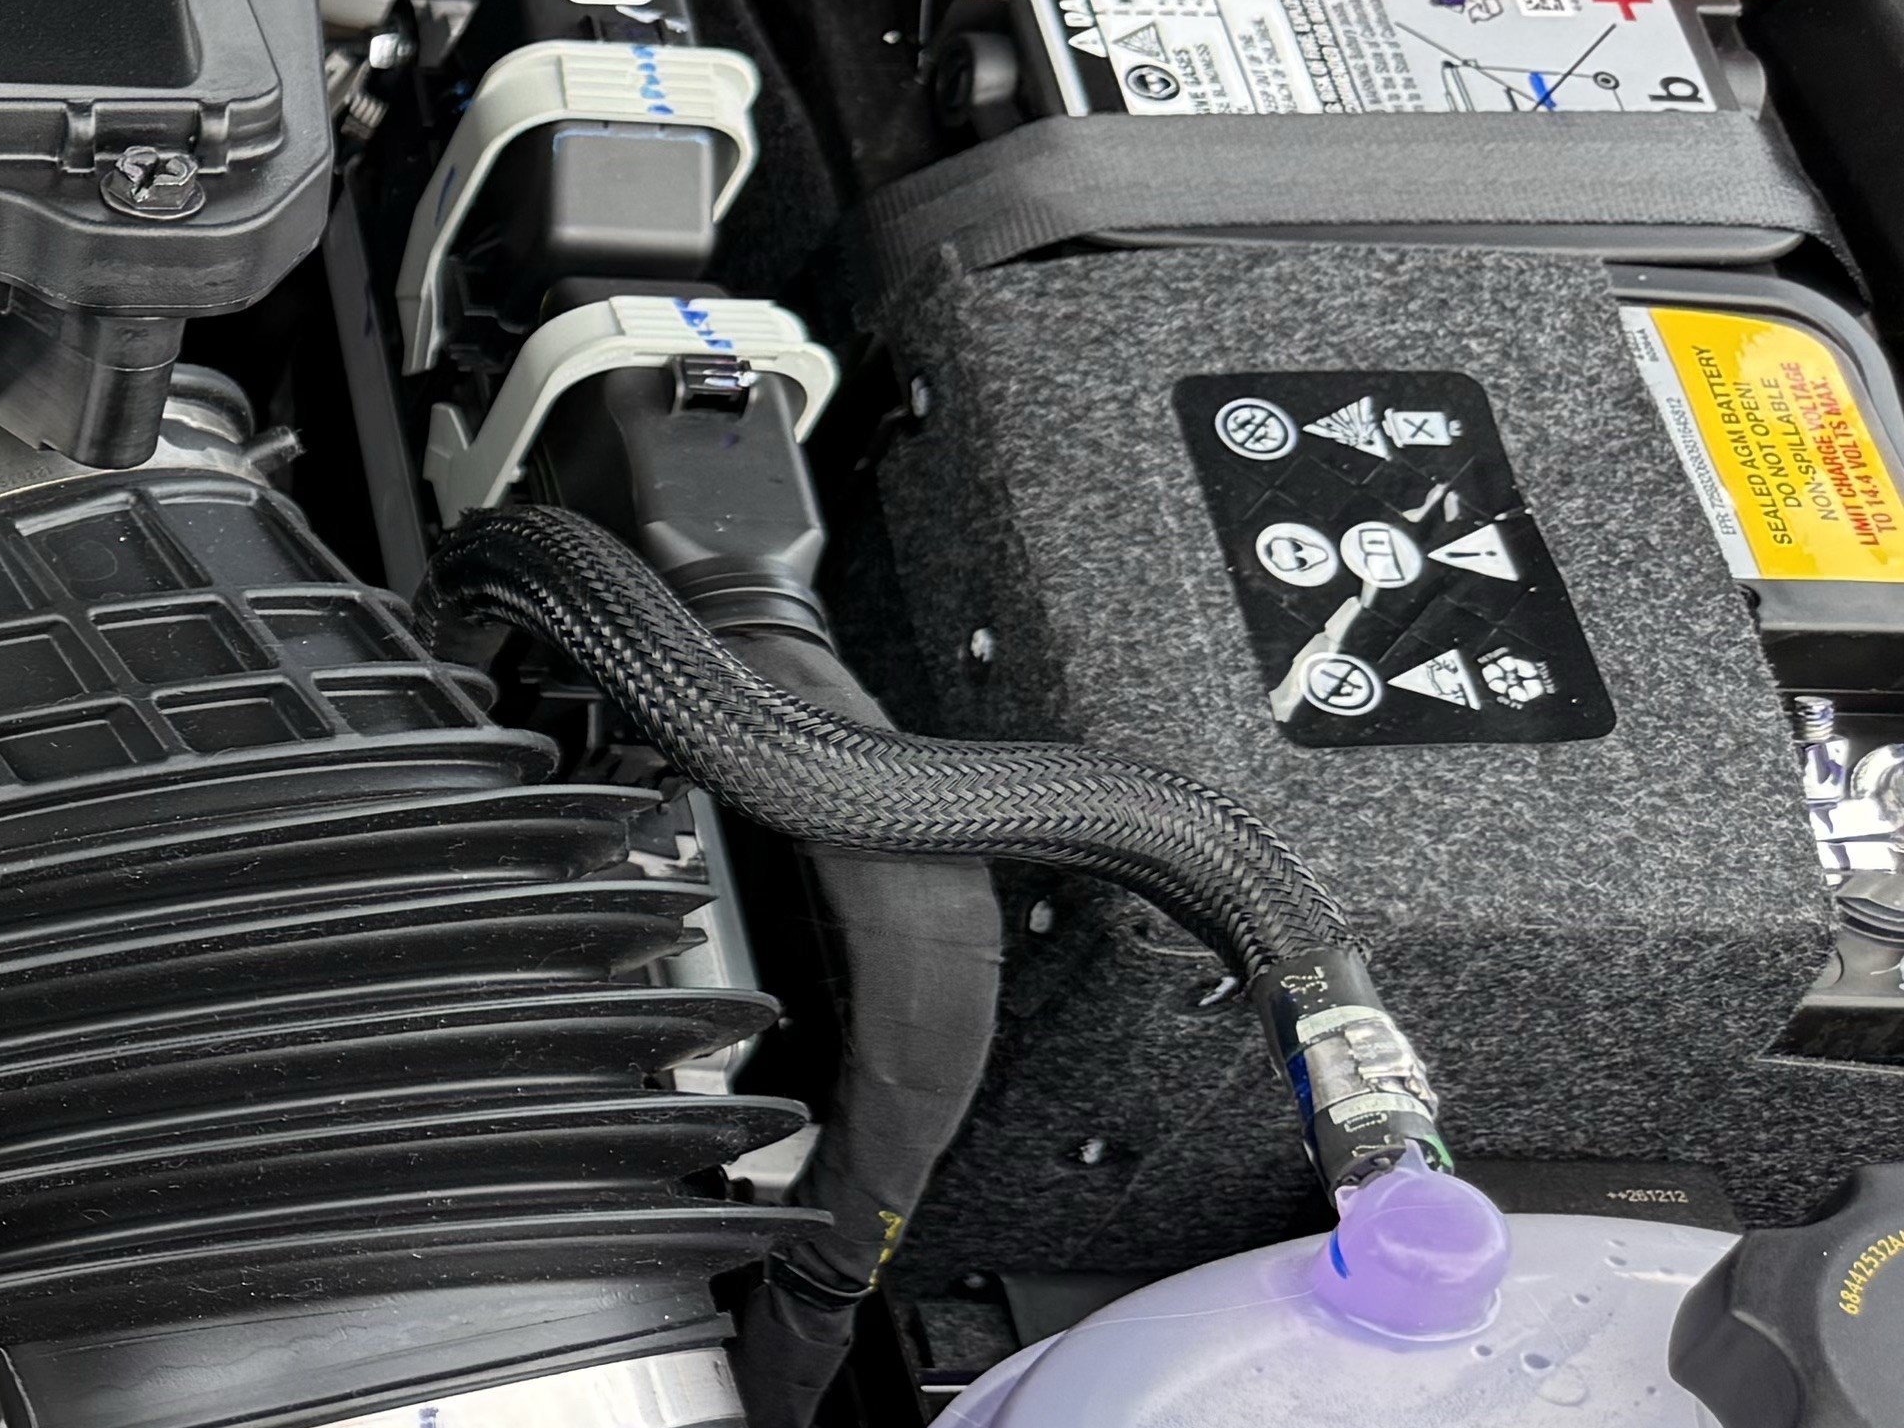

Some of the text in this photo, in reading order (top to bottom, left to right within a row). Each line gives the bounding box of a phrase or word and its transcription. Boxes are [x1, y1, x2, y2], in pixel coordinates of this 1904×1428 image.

[1649, 74, 1704, 104] b
[1690, 345, 1793, 544] SEALED AGM BATTERY
[1732, 381, 1803, 507] DO NOT OPEN!
[1758, 377, 1839, 520] NON-SPILLABLE
[1779, 361, 1880, 545] LIMIT CHARGE VOLTAGE
[1808, 376, 1898, 532] TO 14.4 VOLTS MAX.
